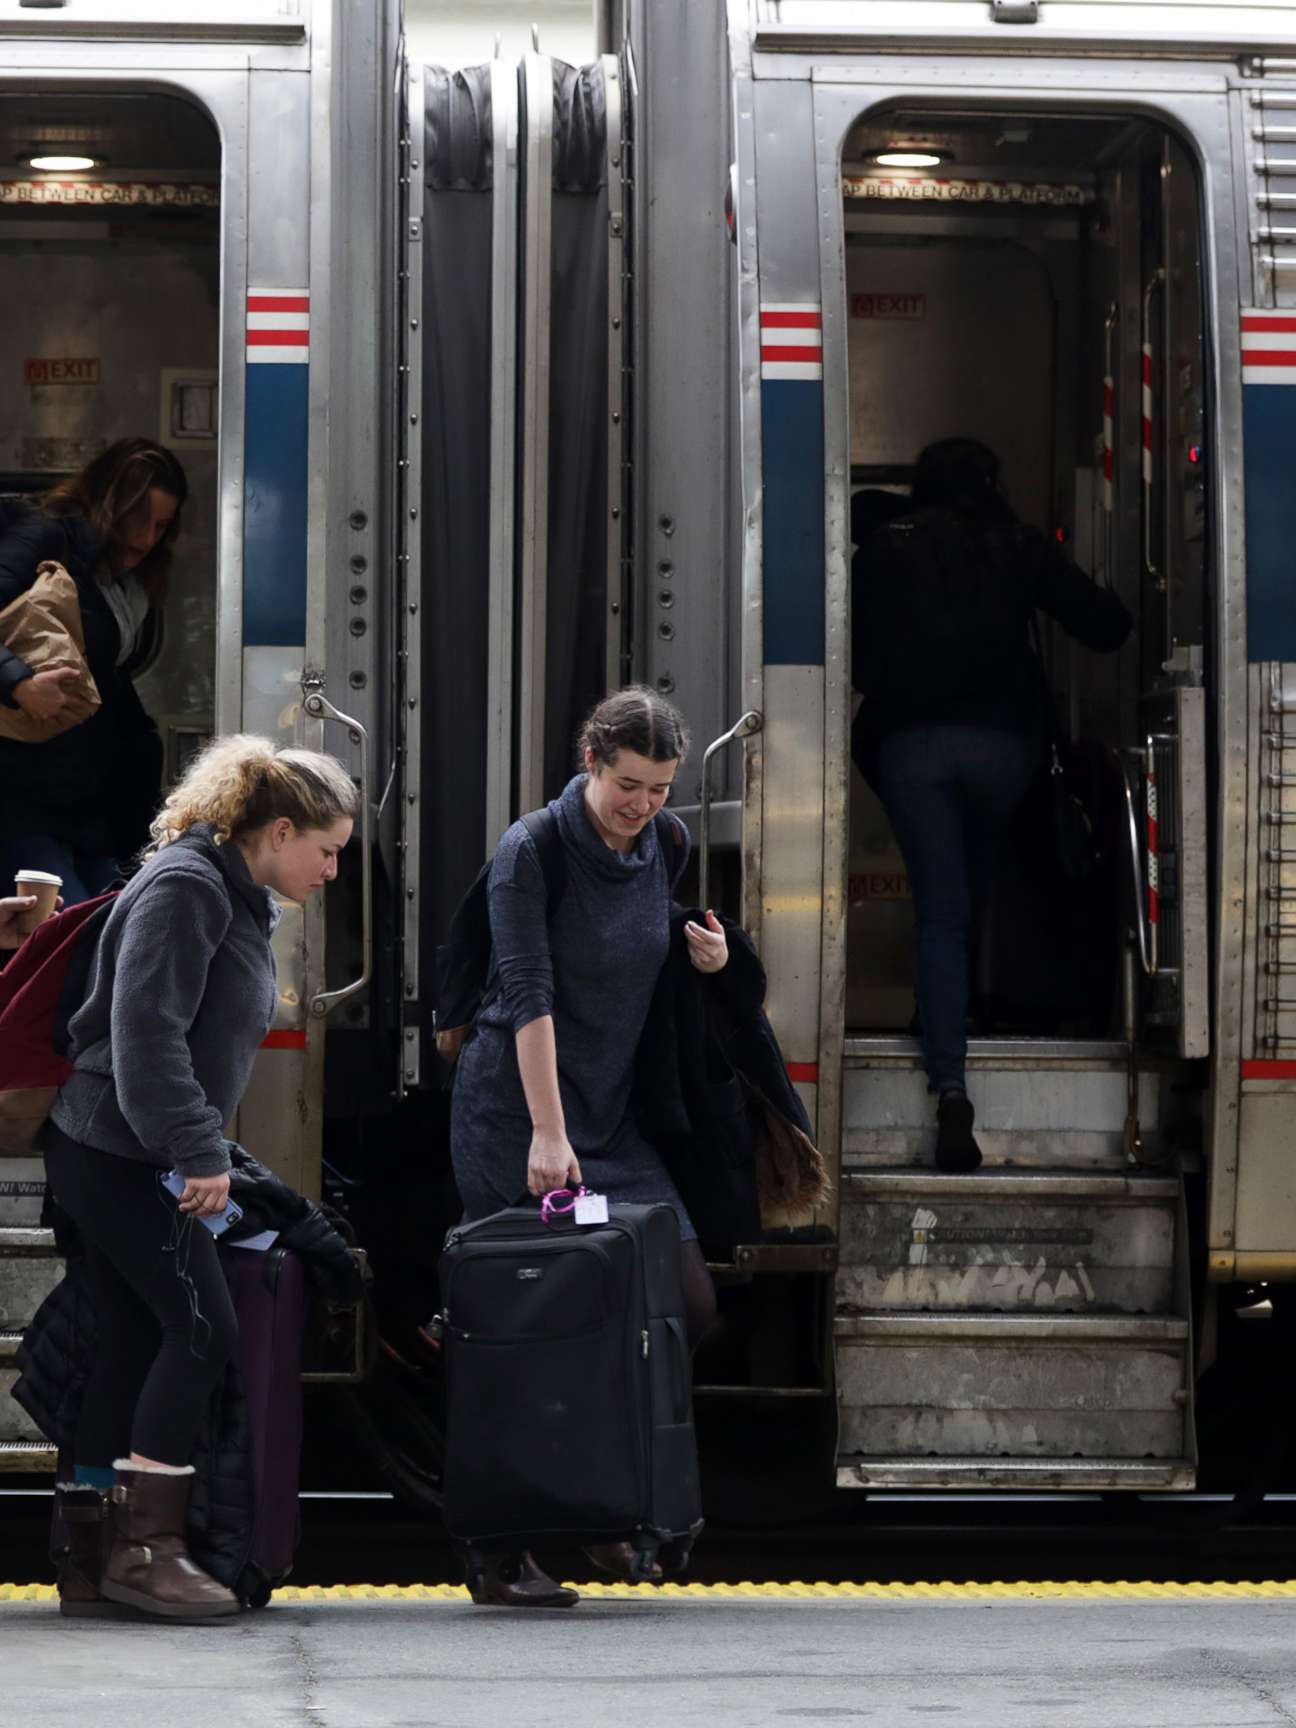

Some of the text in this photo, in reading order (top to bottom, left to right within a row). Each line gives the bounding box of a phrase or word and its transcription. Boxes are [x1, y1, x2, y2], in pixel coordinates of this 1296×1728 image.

[17, 187, 95, 202] BETWEEN
[101, 189, 132, 203] CAR
[866, 185, 941, 199] BETWEEN
[948, 187, 978, 200] CAR
[878, 296, 920, 313] EXIT
[51, 361, 95, 378] EXIT
[17, 1182, 46, 1194] Watc
